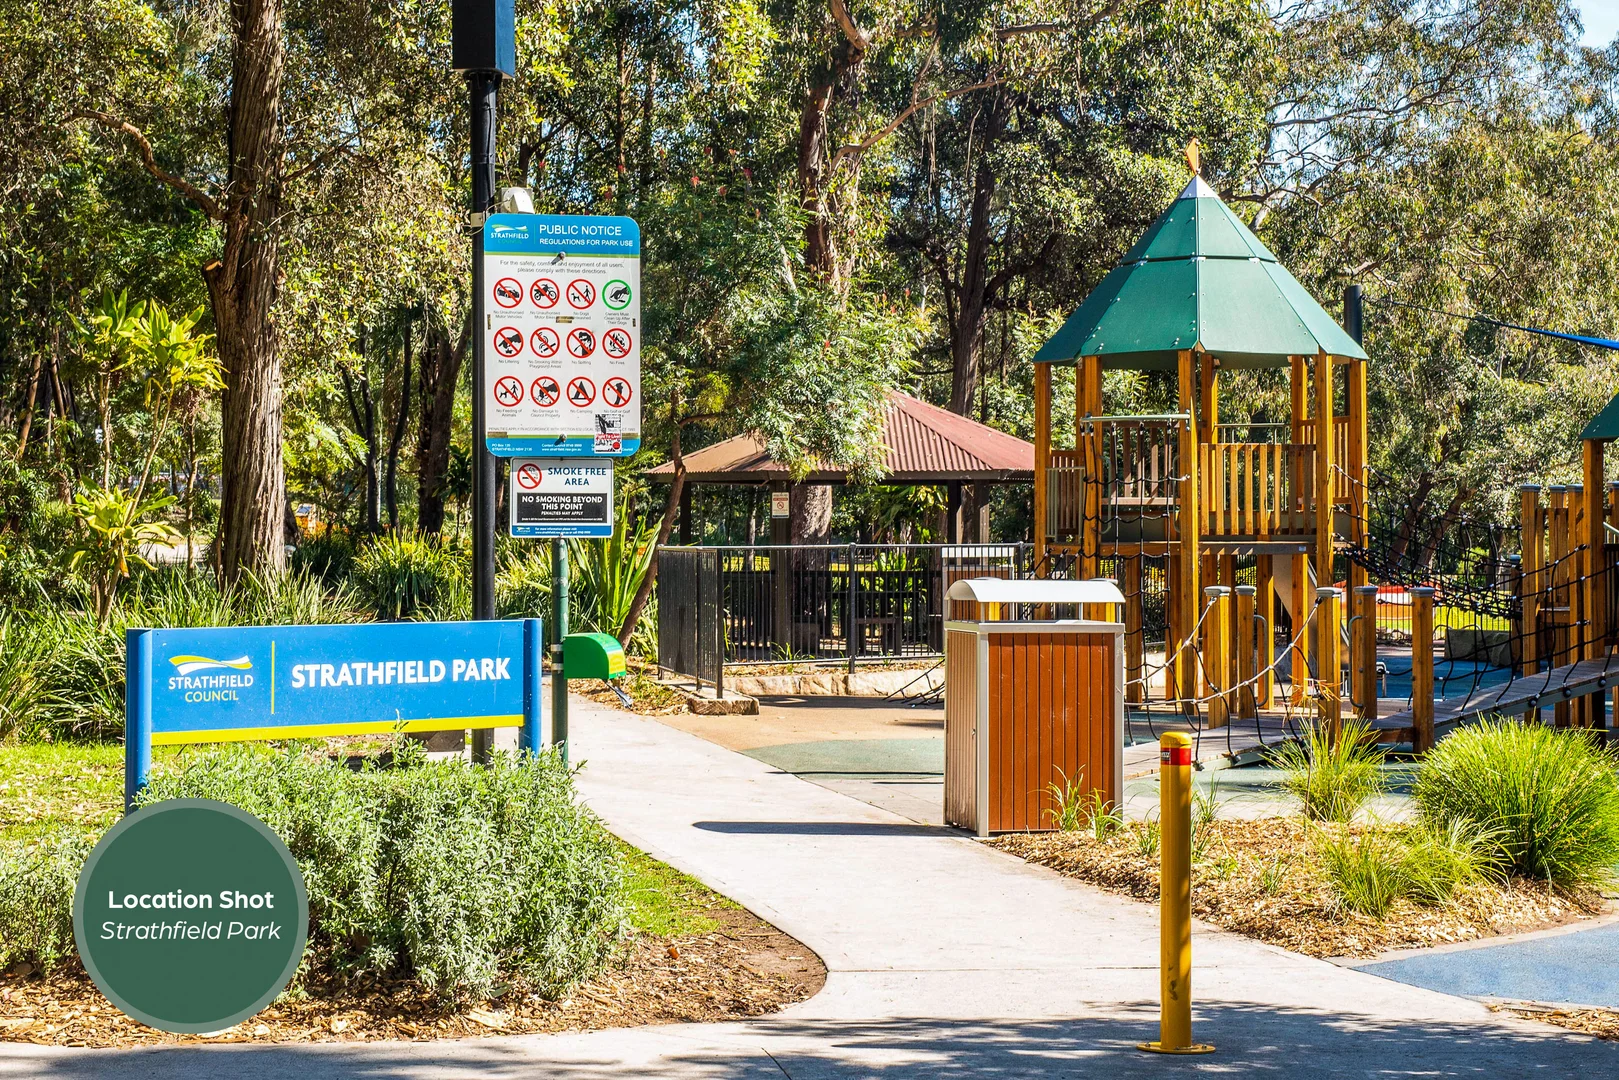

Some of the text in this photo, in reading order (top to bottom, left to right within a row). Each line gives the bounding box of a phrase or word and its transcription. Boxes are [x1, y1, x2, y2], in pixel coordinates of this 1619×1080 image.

[539, 224, 622, 236] PUBLIC NOTICE
[539, 238, 586, 246] REGULATIONS
[292, 658, 511, 688] STRATHFIELD PARK
[168, 674, 254, 690] STRATHFIELD
[184, 690, 239, 702] COUNCIL
